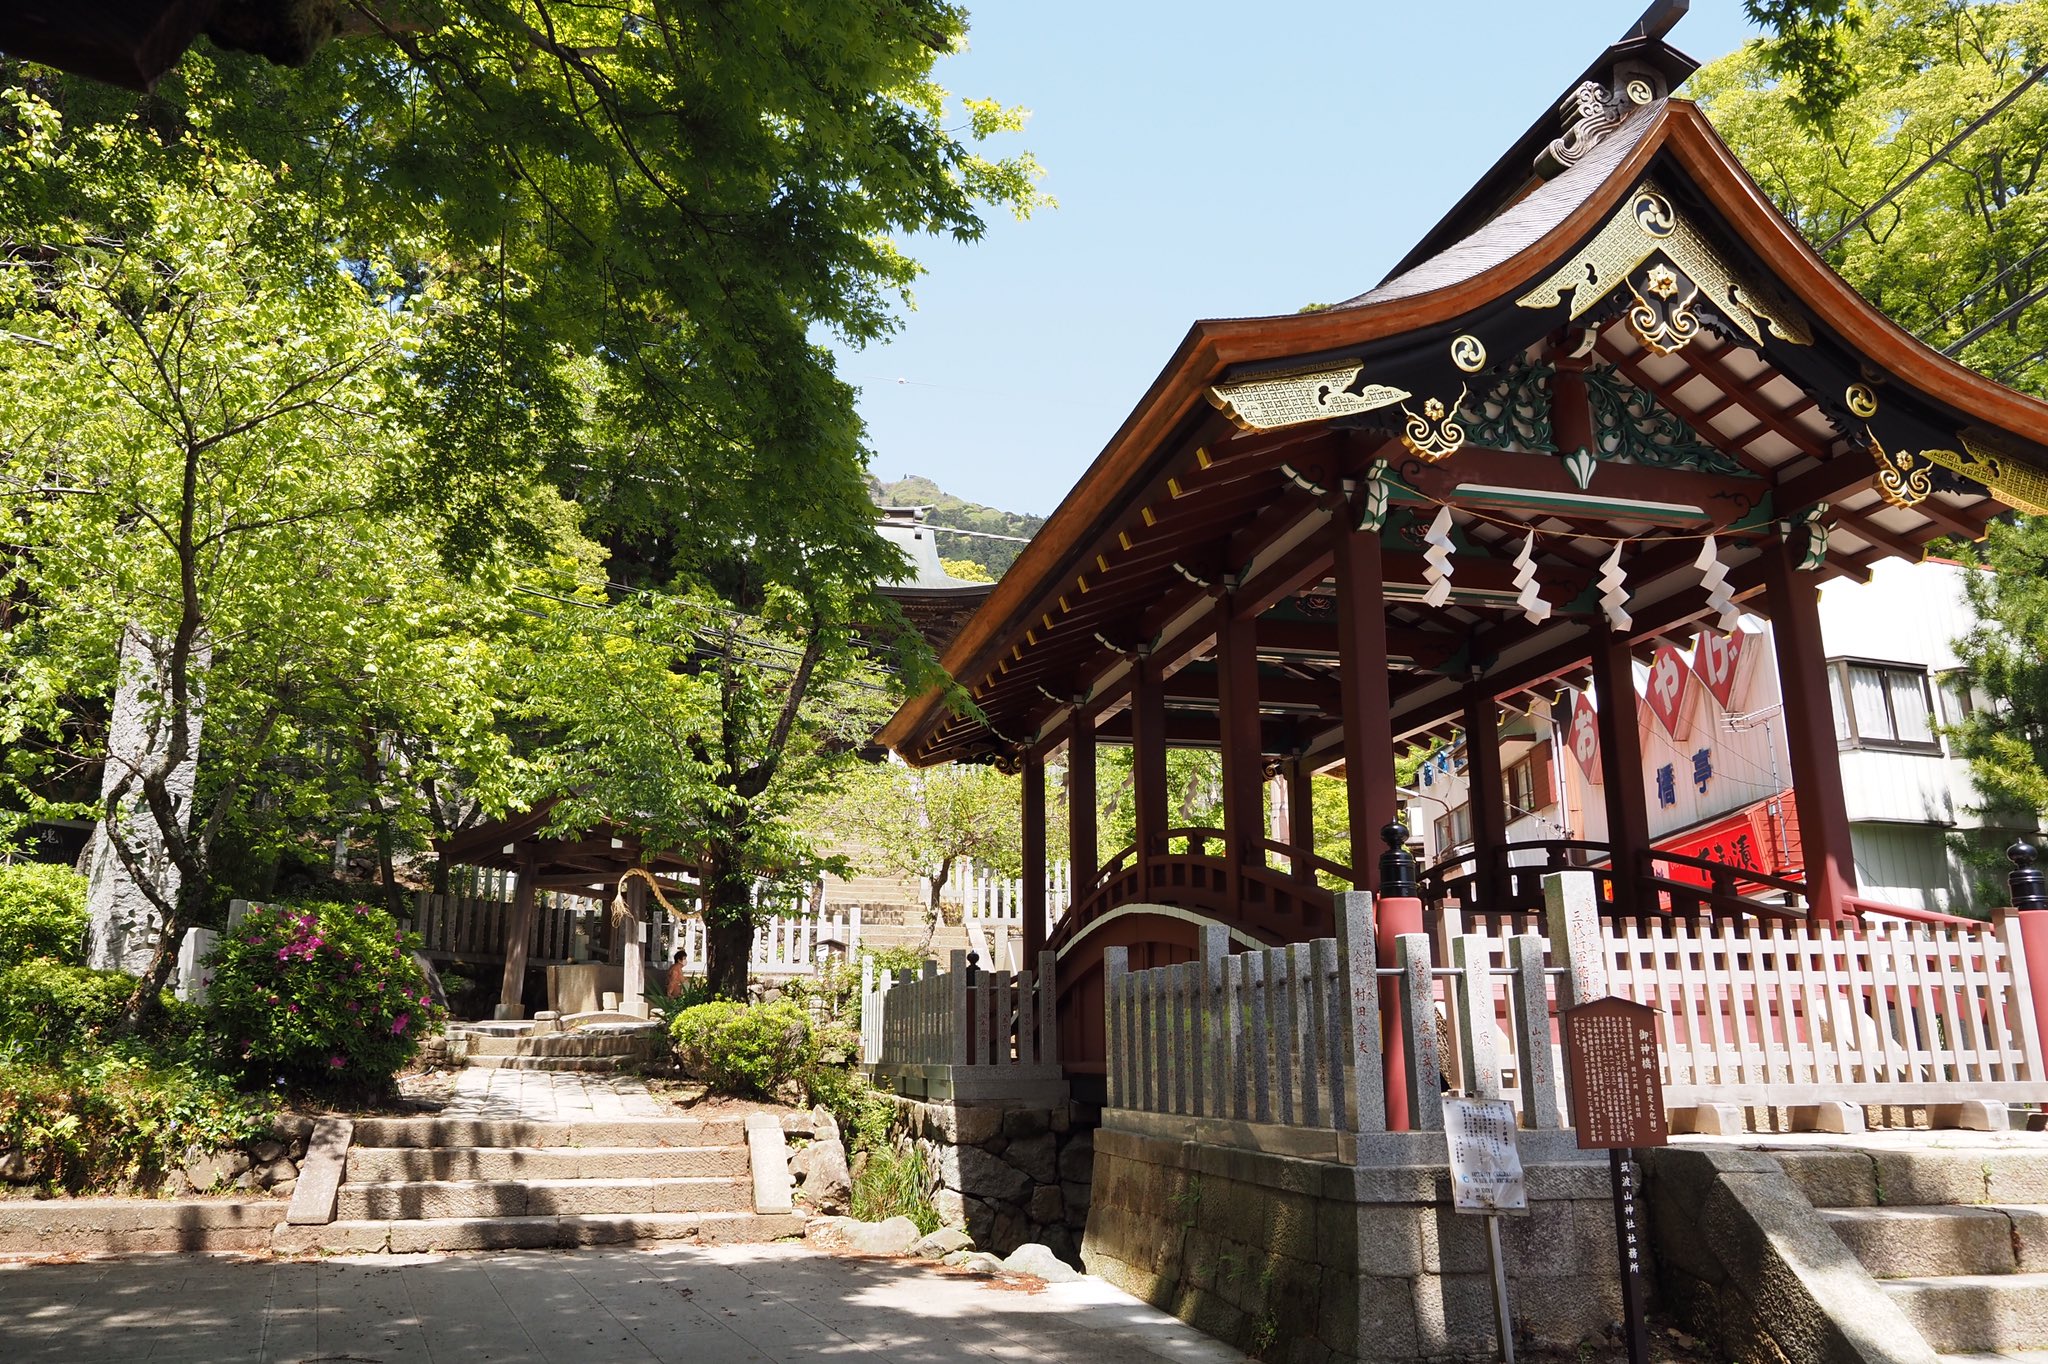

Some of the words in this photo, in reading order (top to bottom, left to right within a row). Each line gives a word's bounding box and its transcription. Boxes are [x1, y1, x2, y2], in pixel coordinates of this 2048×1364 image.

[1620, 1162, 1640, 1274] 筑波山神社社務所
